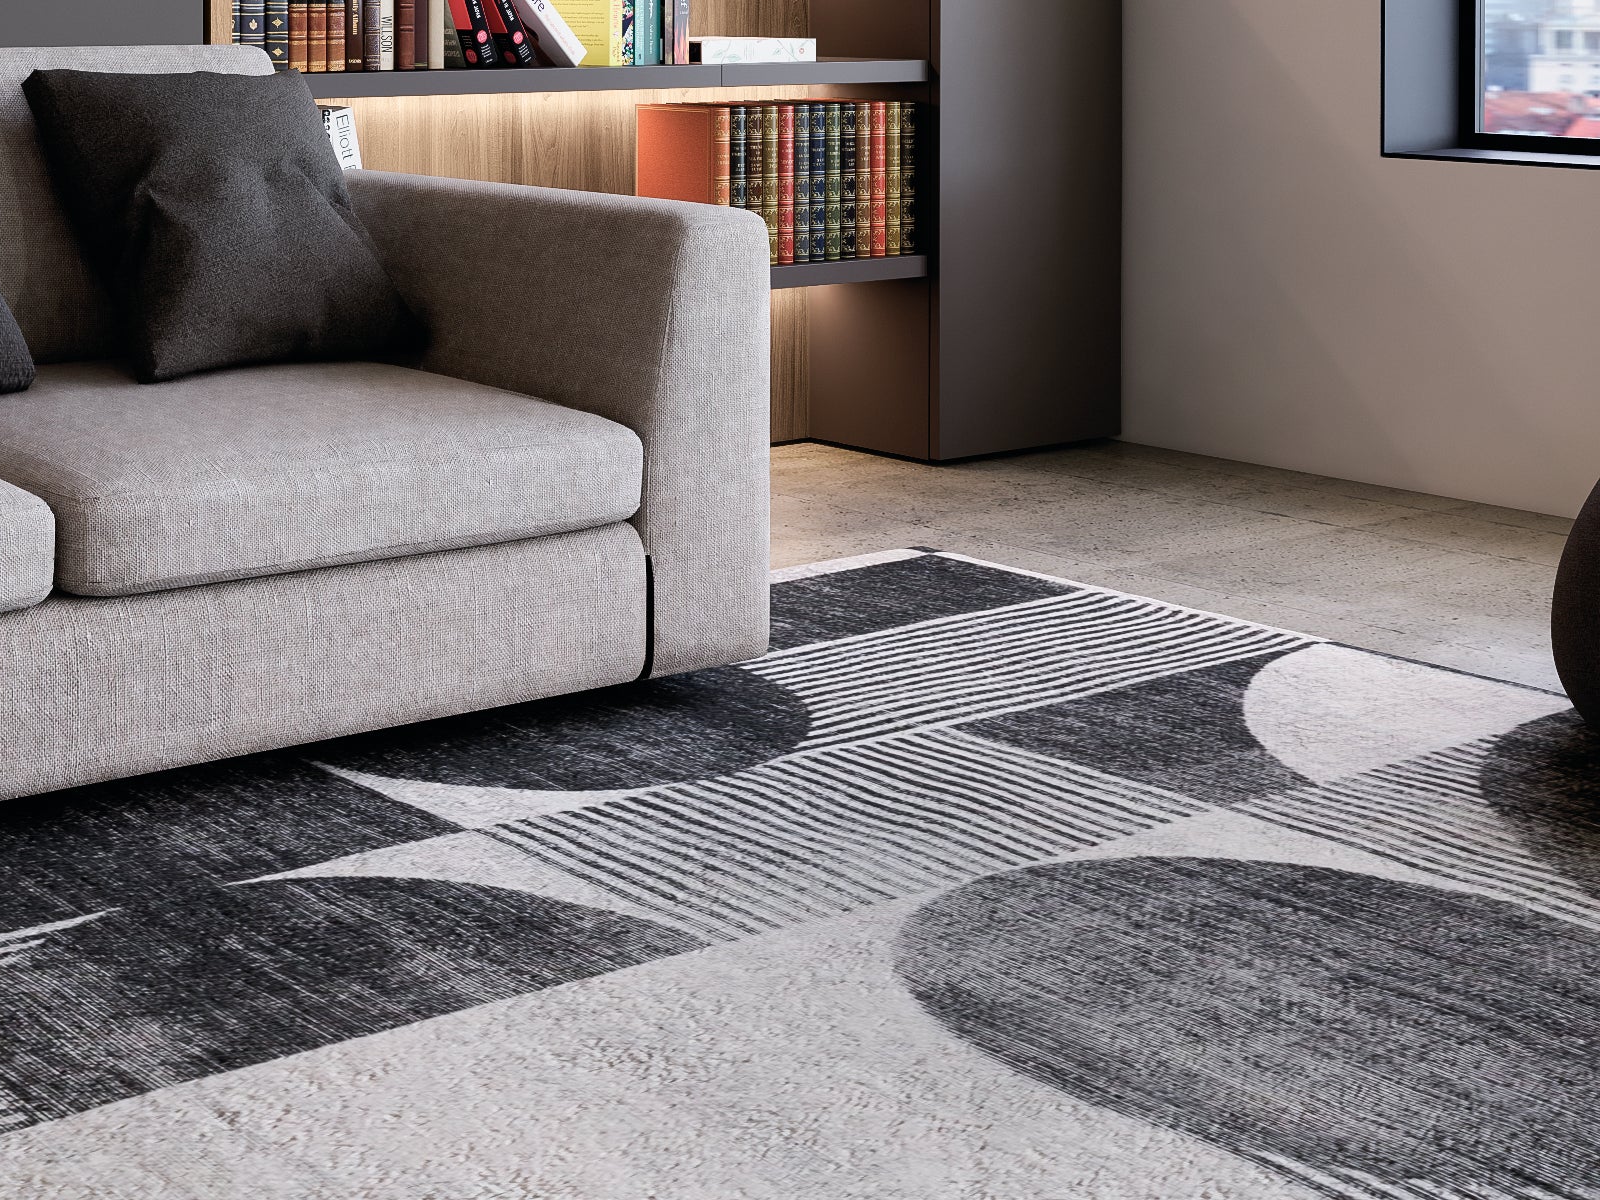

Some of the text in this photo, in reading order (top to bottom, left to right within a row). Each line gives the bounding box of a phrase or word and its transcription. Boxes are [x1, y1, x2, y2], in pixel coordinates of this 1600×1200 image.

[352, 13, 360, 35] Album
[380, 15, 393, 53] WILLSON
[335, 113, 354, 161] Elliott
